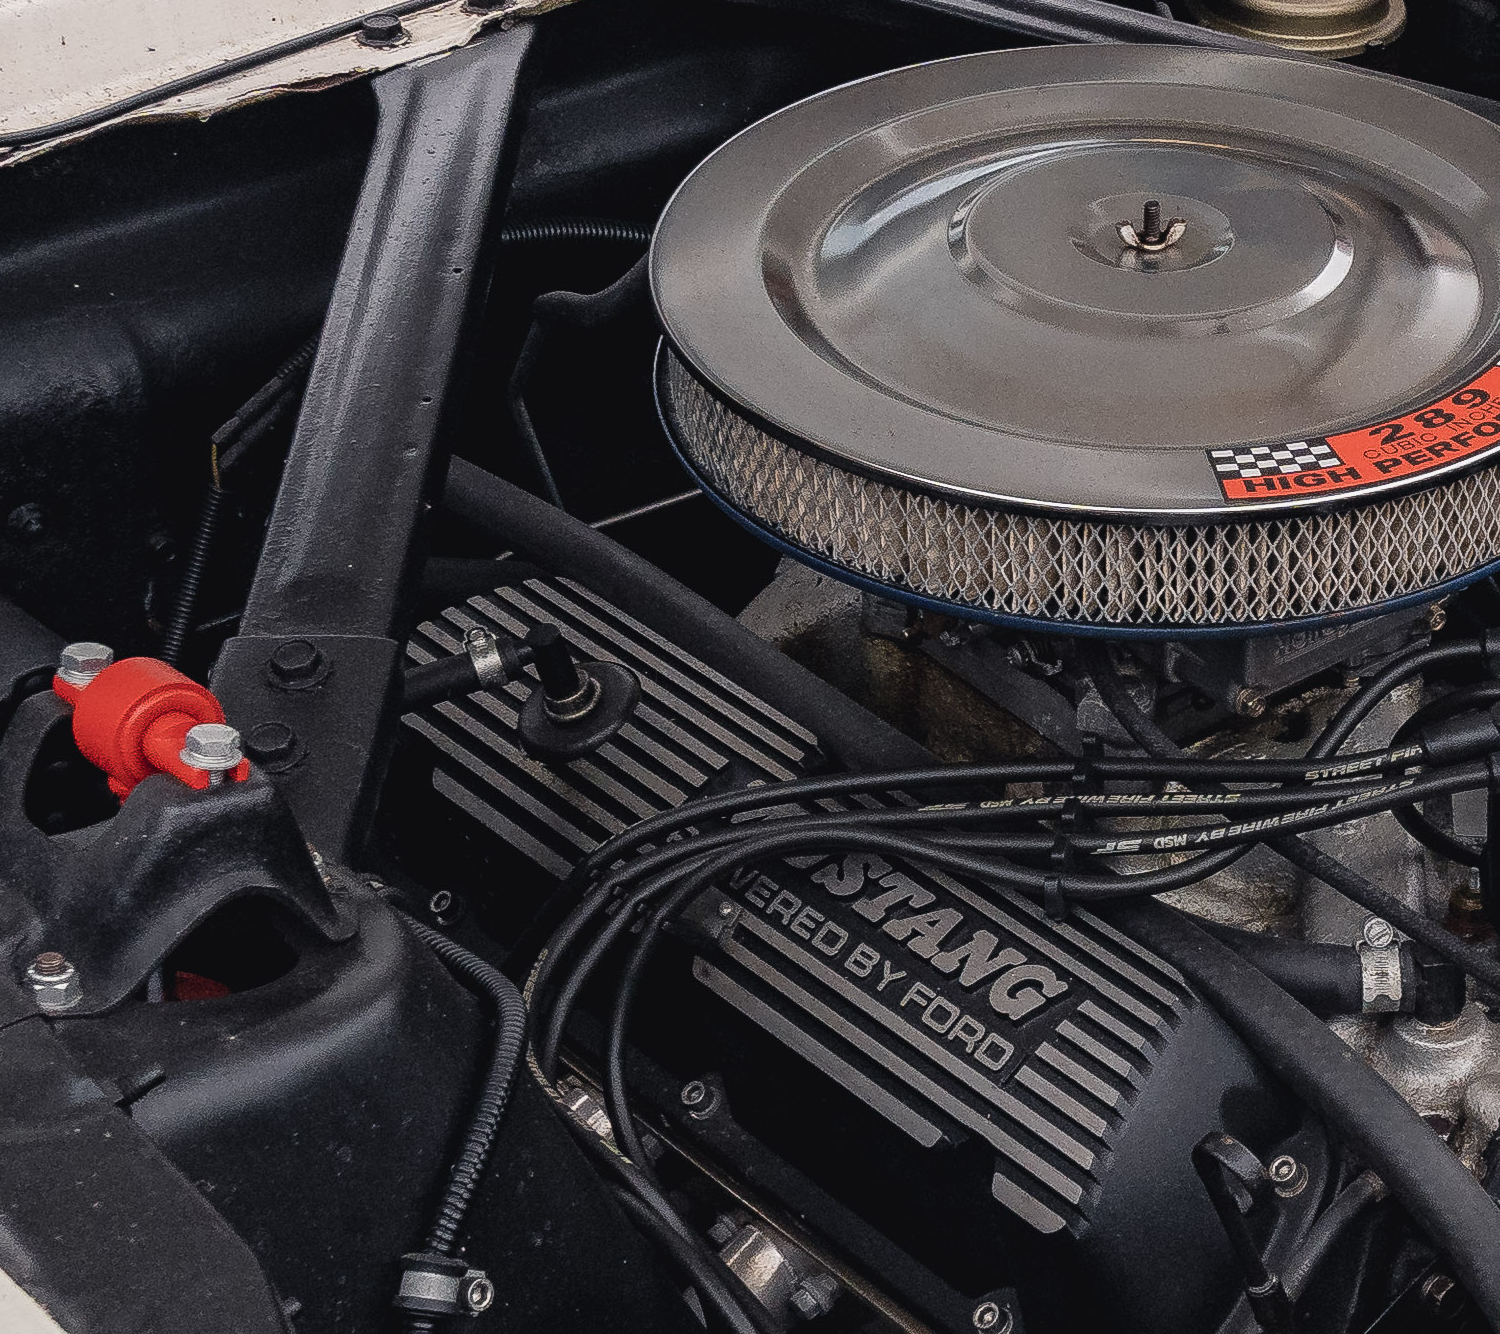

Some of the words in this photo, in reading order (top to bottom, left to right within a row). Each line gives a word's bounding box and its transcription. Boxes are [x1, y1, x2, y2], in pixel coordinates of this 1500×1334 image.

[1368, 388, 1491, 446] 289
[1363, 432, 1438, 460] CUBIC
[1243, 467, 1363, 494] HIGH
[1304, 754, 1387, 780] STREET
[1153, 833, 1188, 850] MSD
[1194, 825, 1227, 844] BY
[784, 853, 1068, 1020] STANG
[844, 941, 909, 993] BY
[901, 980, 1016, 1072] FORD
